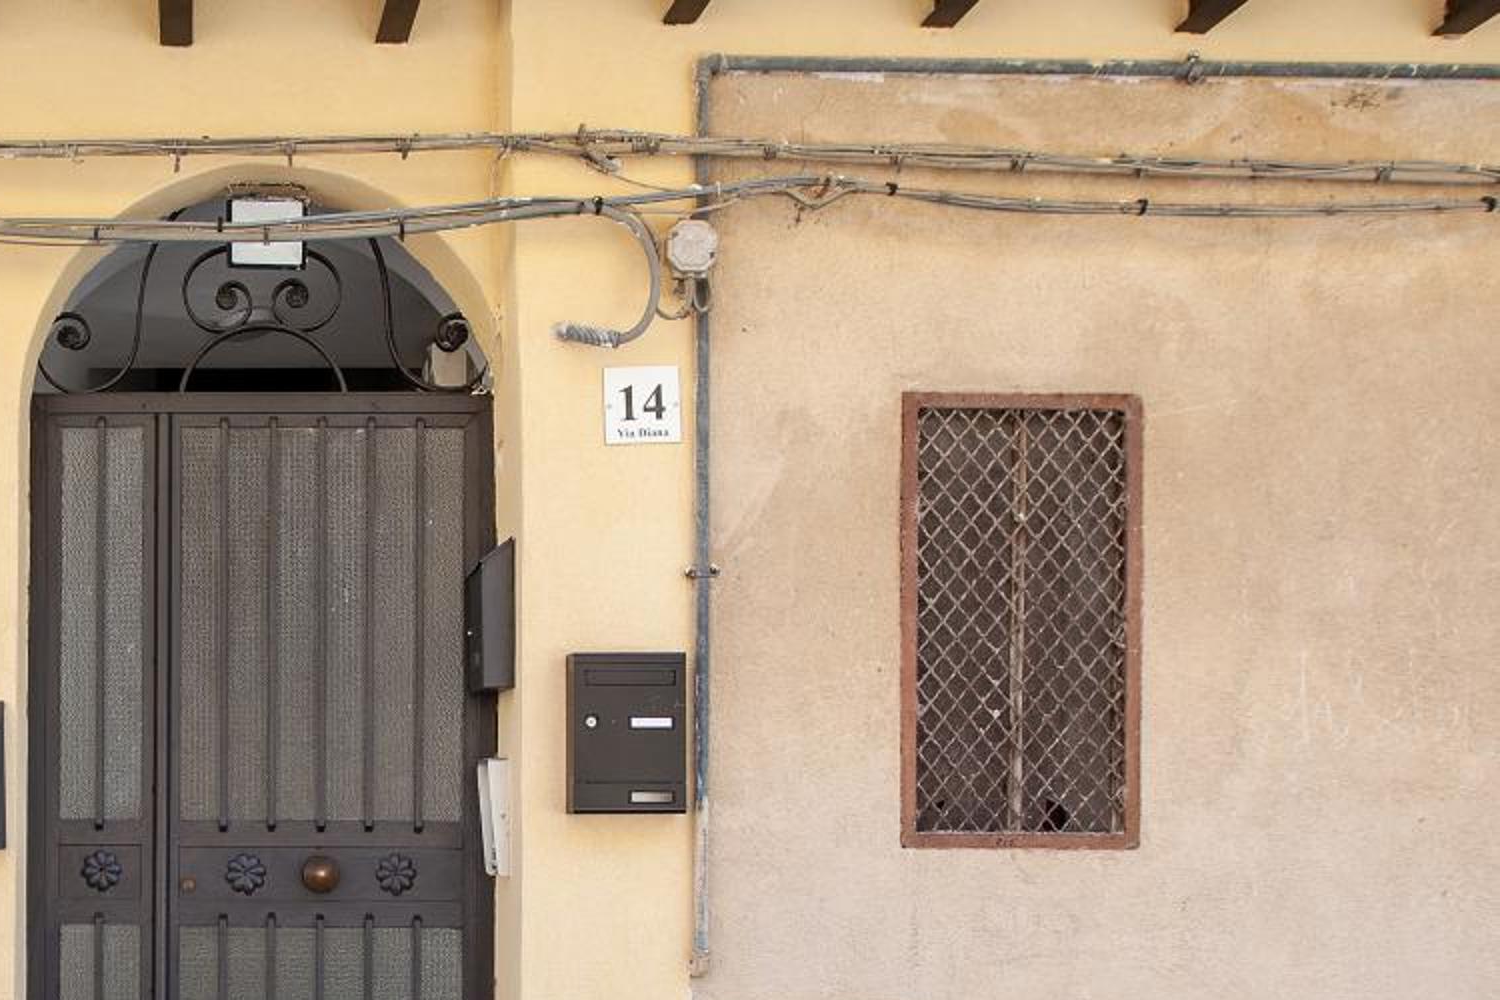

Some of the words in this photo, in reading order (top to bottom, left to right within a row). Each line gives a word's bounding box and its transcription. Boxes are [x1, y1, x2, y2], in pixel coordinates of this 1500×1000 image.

[618, 383, 667, 421] 14
[617, 428, 636, 438] Via
[638, 427, 670, 438] Diana
